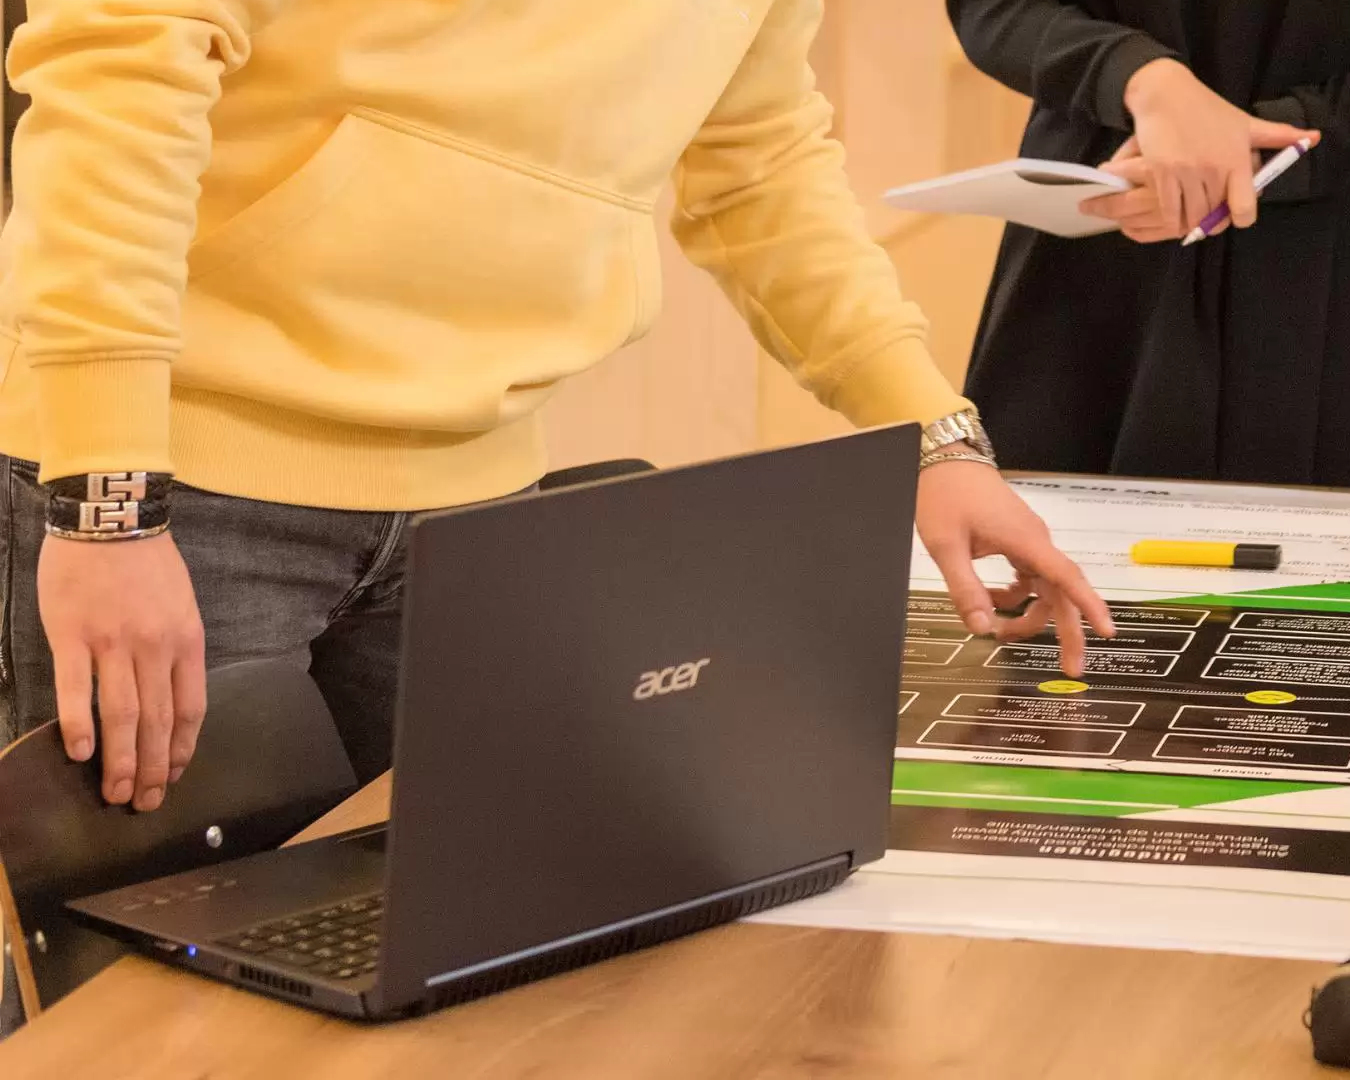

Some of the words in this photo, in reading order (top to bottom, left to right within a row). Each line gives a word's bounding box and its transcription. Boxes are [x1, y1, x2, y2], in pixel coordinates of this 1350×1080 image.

[633, 658, 711, 700] acer
[952, 825, 1008, 835] gevoel
[986, 820, 1121, 835] vrienden/familie
[1126, 828, 1148, 836] op
[952, 832, 1040, 844] beheersen
[1011, 828, 1106, 840] community
[1111, 834, 1146, 843] echt
[1153, 830, 1209, 840] maken
[1215, 834, 1268, 843] Indruk
[1043, 837, 1088, 846] goed
[1151, 837, 1181, 845] een
[1187, 839, 1224, 848] voor
[1091, 840, 1187, 852] onderdelen
[1193, 846, 1214, 854] de
[1230, 841, 1289, 851] Zorgen
[1038, 844, 1186, 862] Uitdagingen
[1219, 848, 1251, 856] drie
[1257, 850, 1288, 858] Alle
